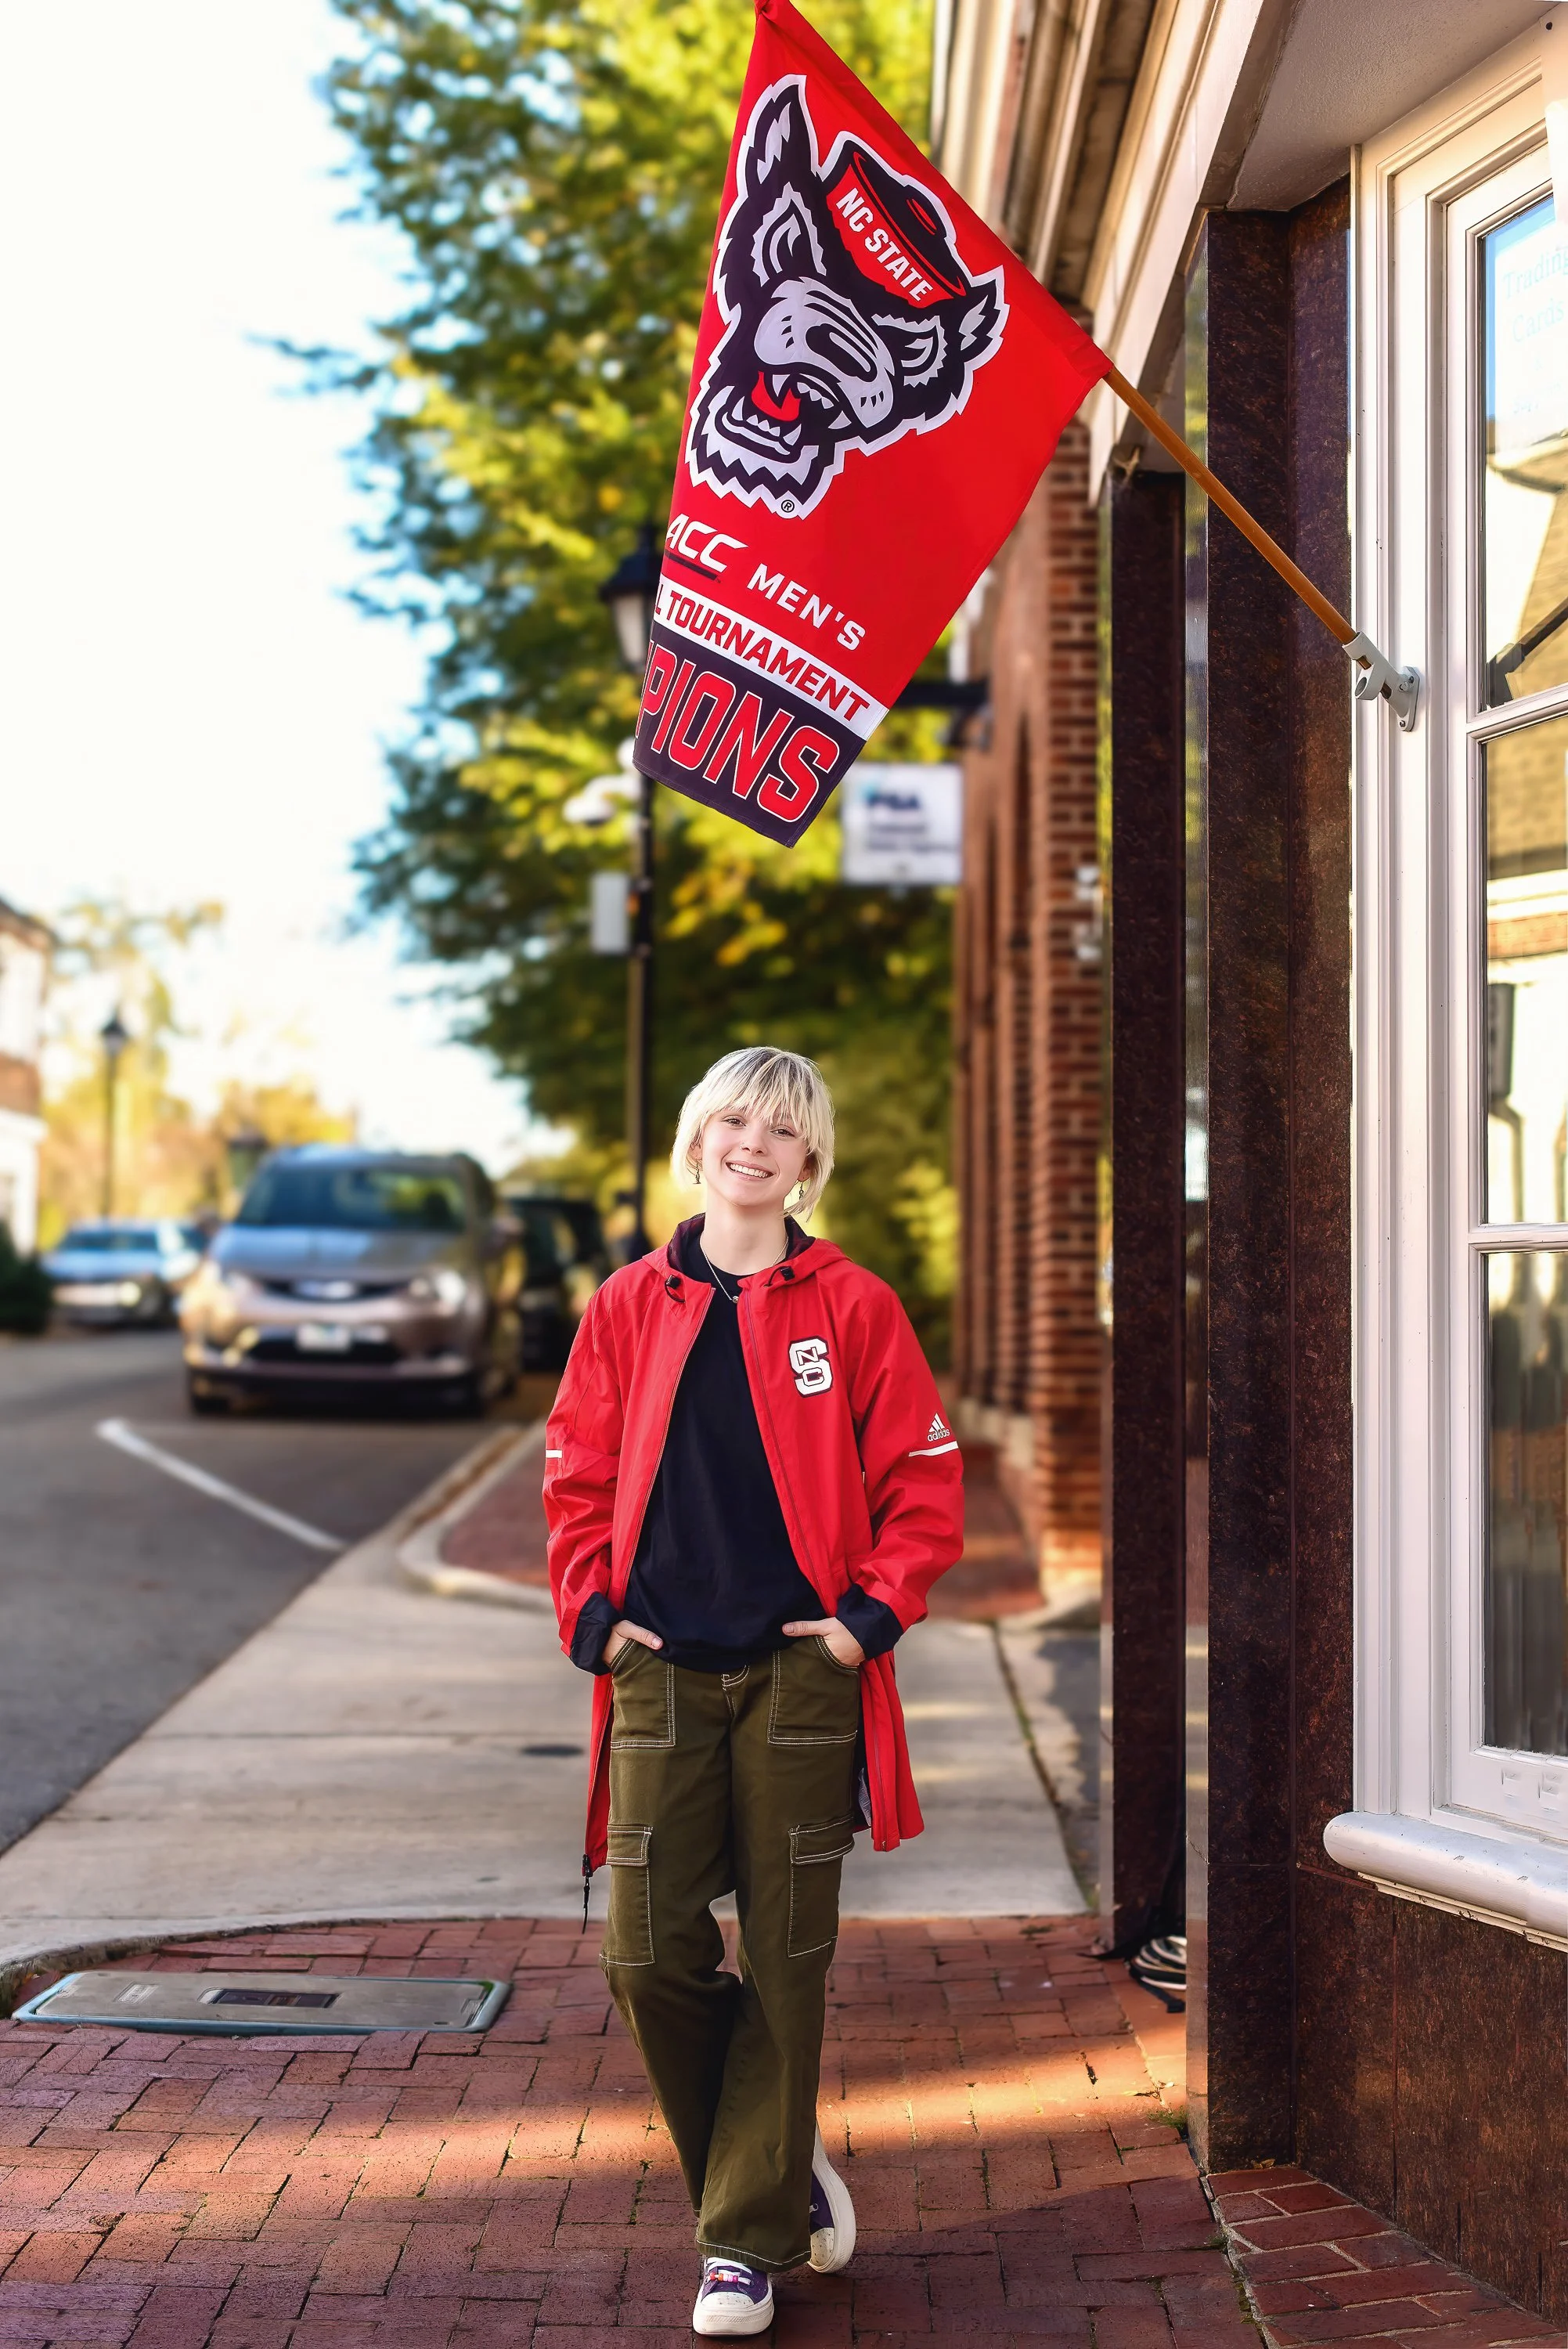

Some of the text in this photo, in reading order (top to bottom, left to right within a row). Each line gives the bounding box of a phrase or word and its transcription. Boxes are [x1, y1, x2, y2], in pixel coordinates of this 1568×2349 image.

[836, 187, 934, 301] NC STATE
[1512, 298, 1565, 344] Cards
[665, 513, 867, 651] ACC MEN'S
[666, 590, 871, 722] TOURNAMENT
[636, 639, 840, 823] PIONS
[927, 1428, 950, 1442] adidas
